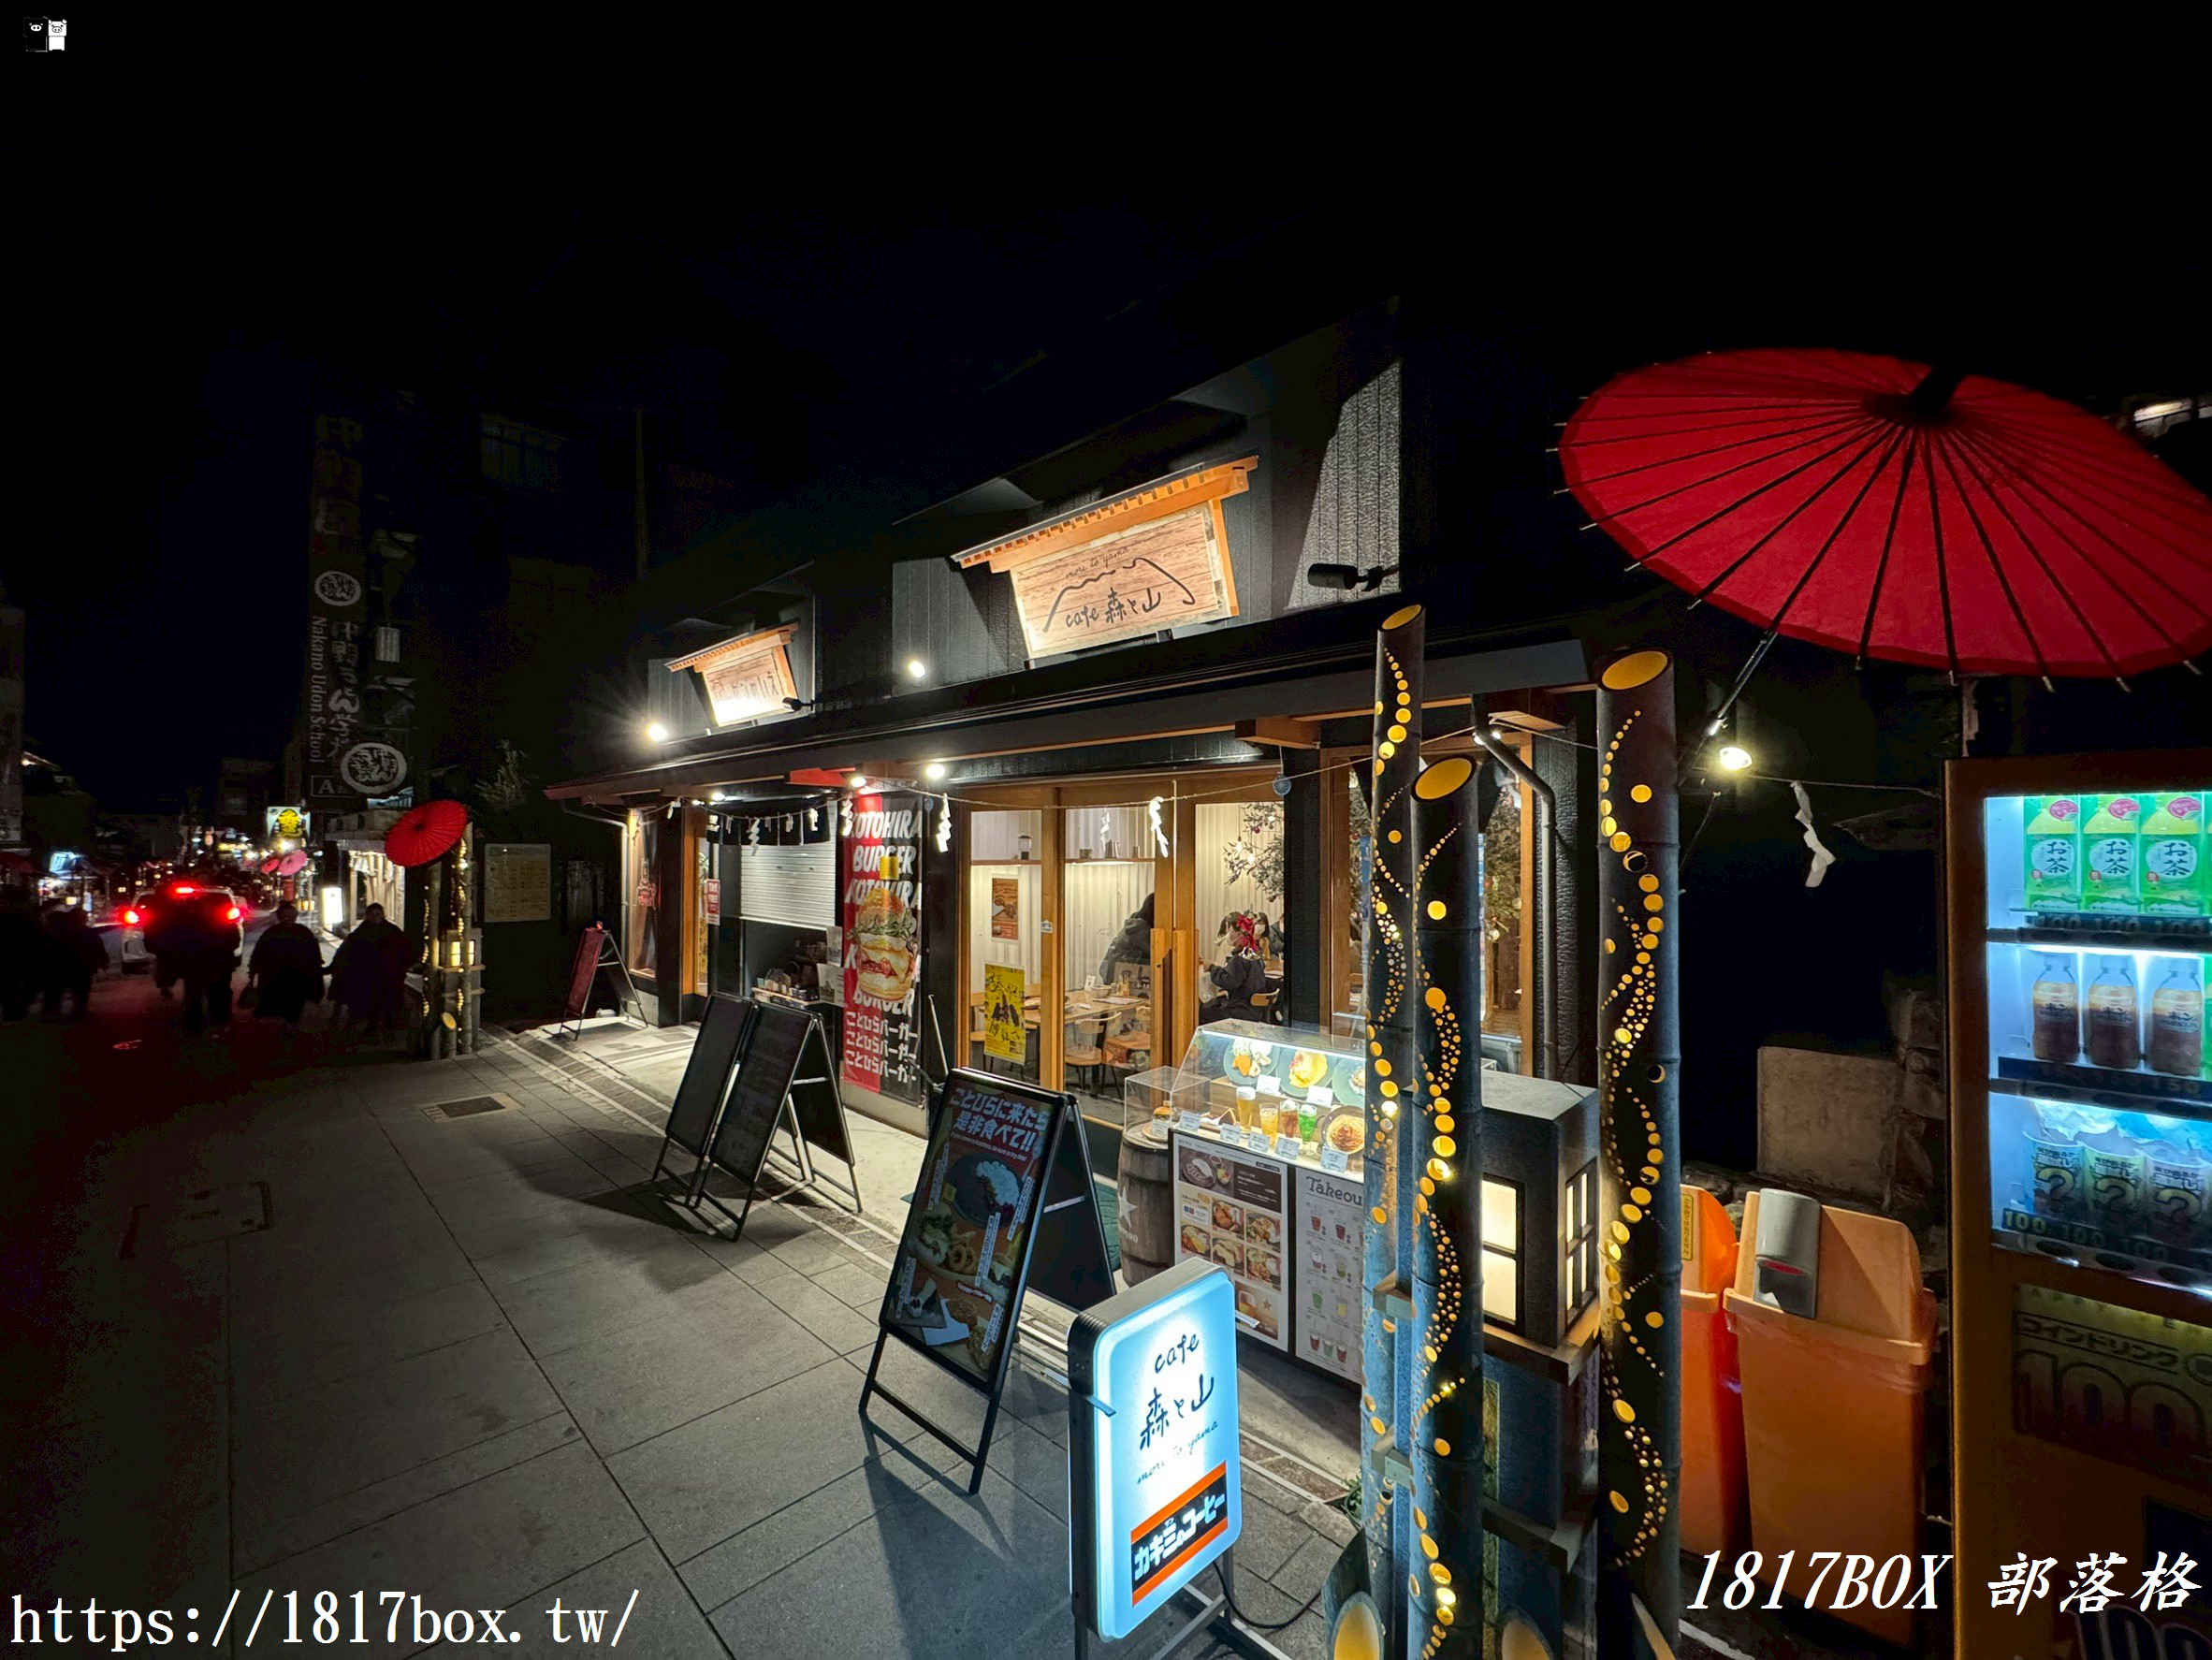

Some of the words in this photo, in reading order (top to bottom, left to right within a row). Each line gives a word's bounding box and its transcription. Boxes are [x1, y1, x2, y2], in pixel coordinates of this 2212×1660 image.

[1065, 606, 1099, 628] cafe
[1105, 587, 1161, 624] 森と山
[311, 615, 327, 671] Nakano
[310, 675, 327, 712] Udon
[309, 715, 327, 764] School
[2045, 840, 2069, 875] お茶
[2104, 840, 2129, 875] お茶
[2163, 841, 2190, 876] お茶
[950, 1087, 1051, 1131] ことひらに来たら
[1305, 1175, 1363, 1206] Takeou
[2005, 1209, 2047, 1233] 100
[1154, 1333, 1200, 1374] cafe
[1140, 1373, 1215, 1451] 森と山
